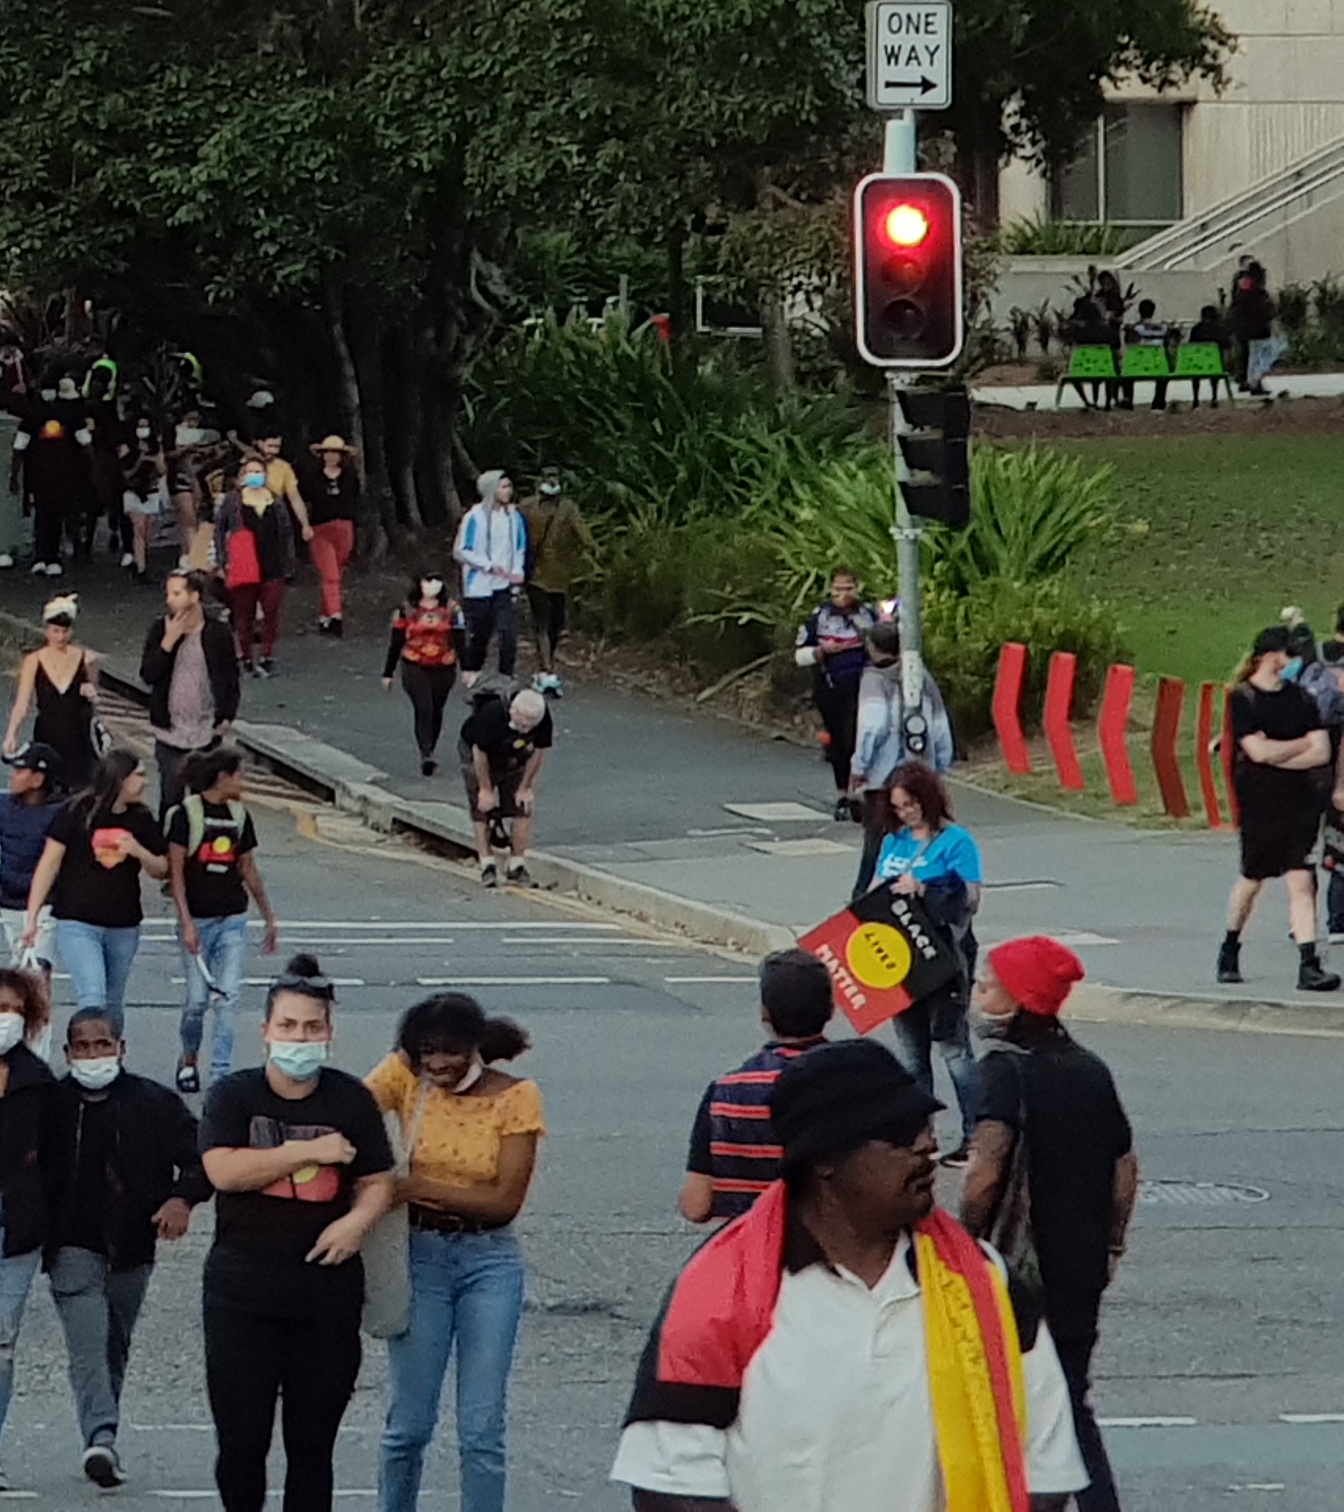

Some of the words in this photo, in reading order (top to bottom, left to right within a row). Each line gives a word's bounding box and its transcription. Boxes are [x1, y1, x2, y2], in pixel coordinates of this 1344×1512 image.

[888, 12, 938, 35] ONE
[884, 44, 940, 67] WAY
[891, 899, 937, 960] BLACK
[864, 932, 898, 970] LIVES
[815, 943, 867, 1011] MATTER
